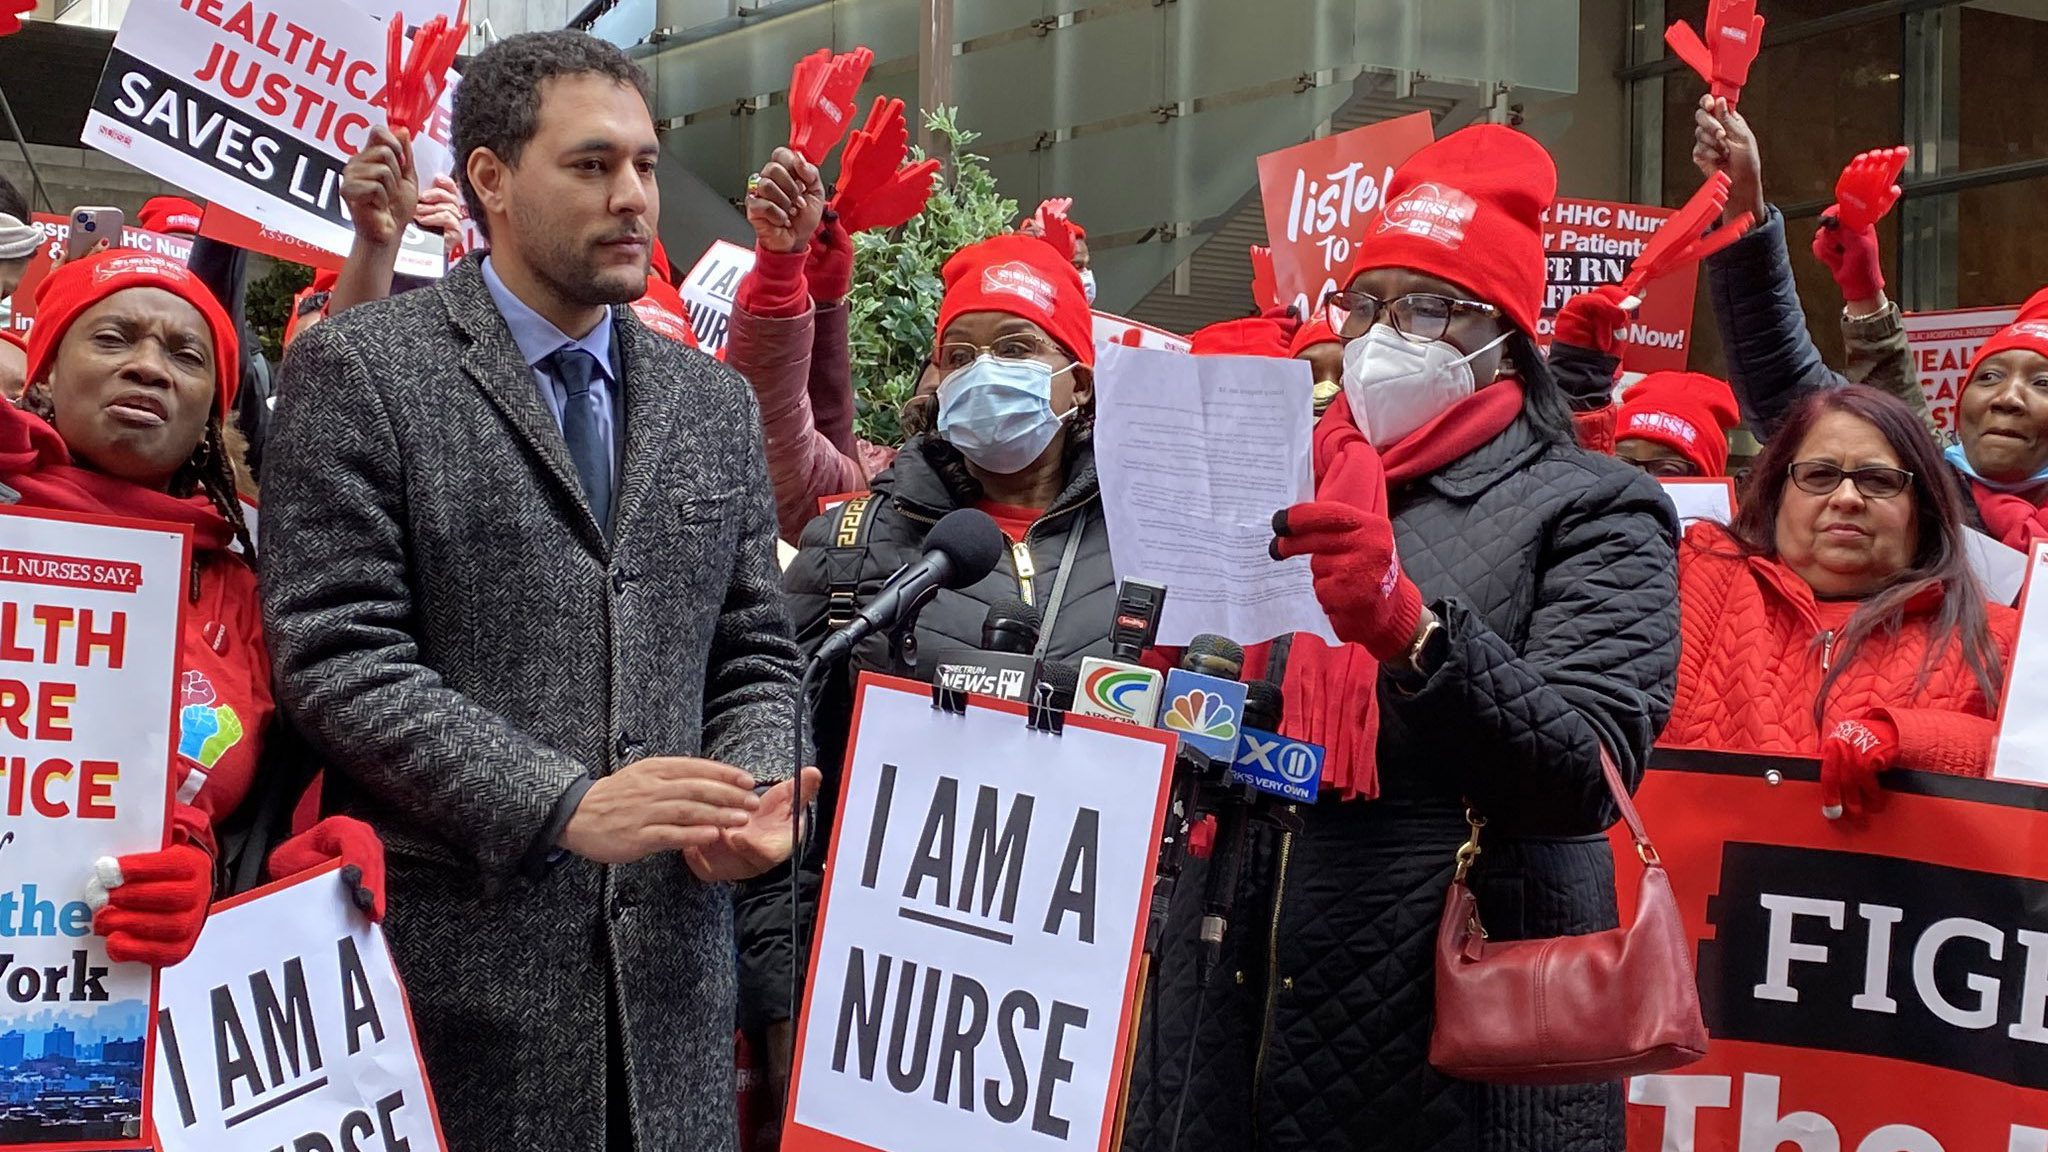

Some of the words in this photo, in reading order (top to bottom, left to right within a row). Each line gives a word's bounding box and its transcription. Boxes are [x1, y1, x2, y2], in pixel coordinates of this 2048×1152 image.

[194, 42, 370, 156] JUSTIC
[113, 71, 280, 181] SAVES
[1556, 203, 1611, 228] HHC
[1617, 209, 1668, 233] Nur
[1579, 257, 1625, 282] RN
[1629, 324, 1684, 350] Now!
[17, 558, 91, 581] NURSES
[93, 566, 134, 586] SAY:
[942, 673, 998, 694] NEWS
[1002, 672, 1022, 683] NY
[1255, 776, 1284, 791] VERY
[1283, 784, 1309, 798] OWN
[861, 763, 898, 890] I
[902, 775, 1036, 925] AM
[1042, 807, 1101, 945] A
[158, 1007, 197, 1129] I
[210, 956, 323, 1111] AM
[338, 935, 386, 1056] A
[831, 946, 1090, 1141] NURSE
